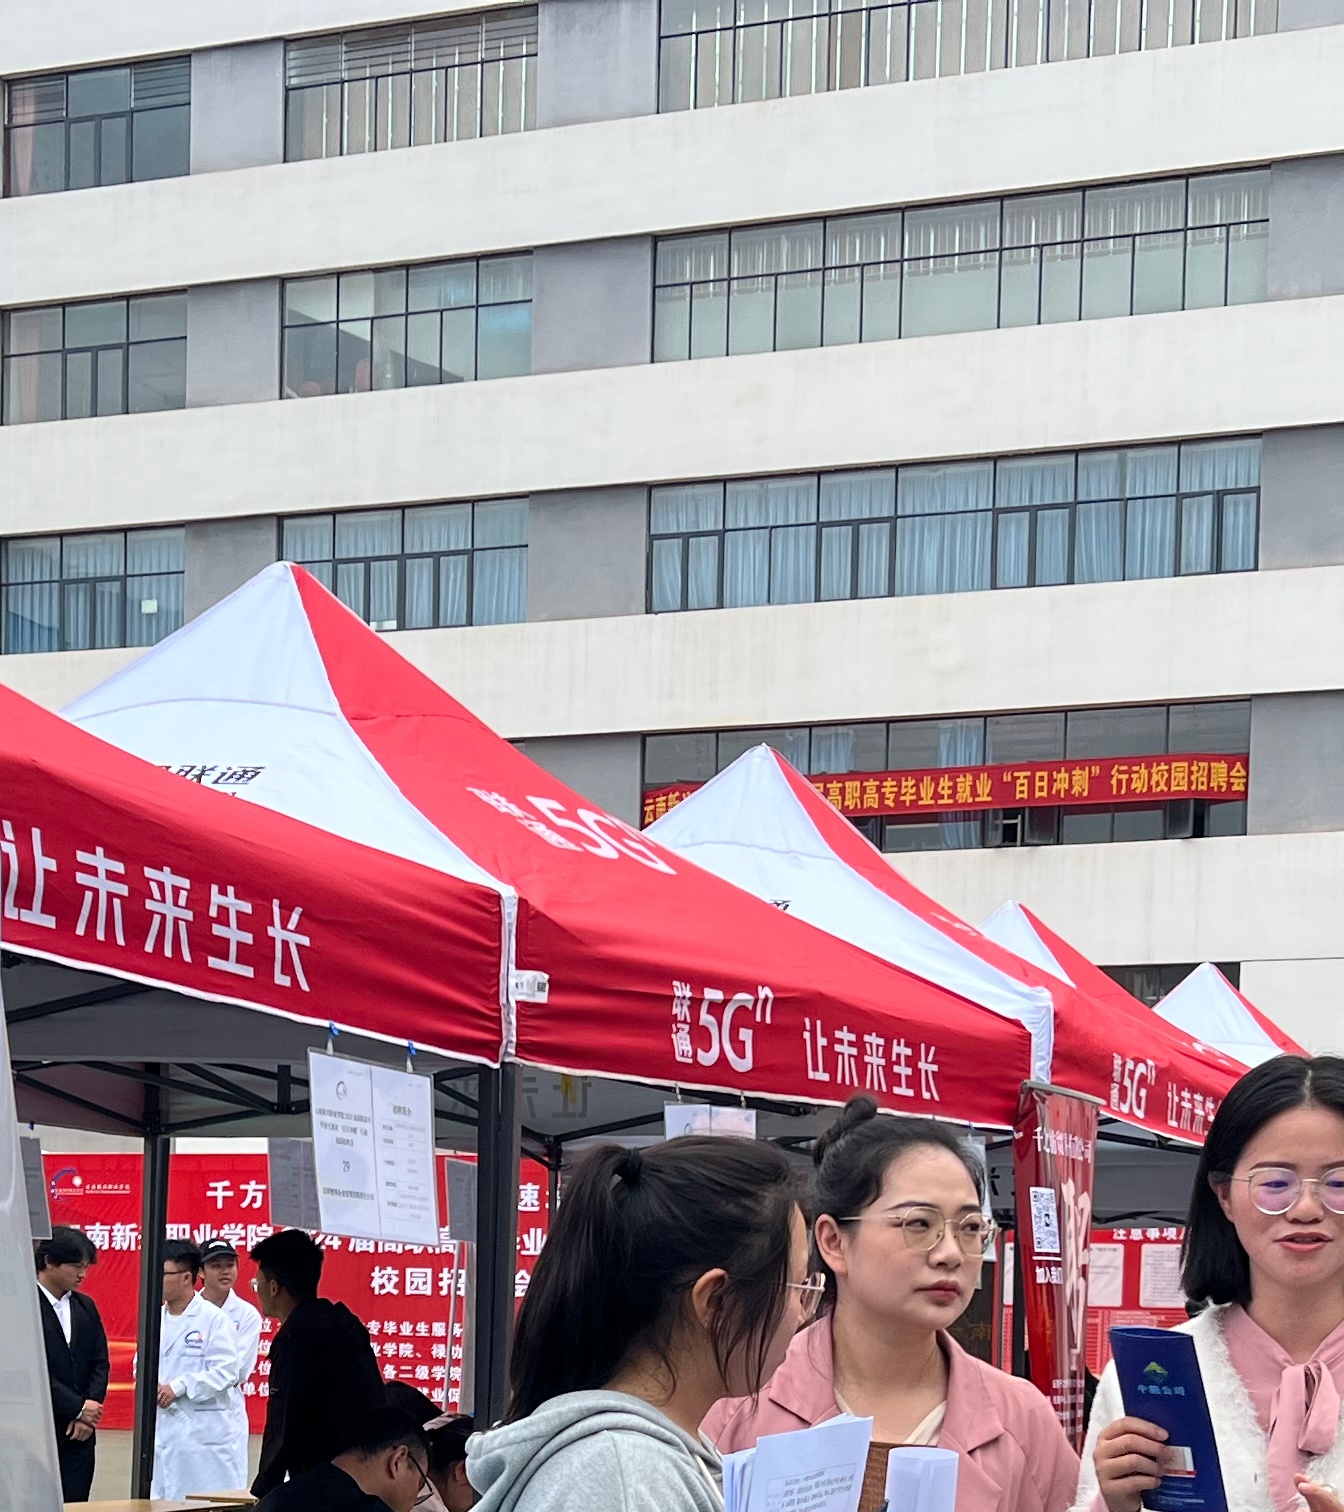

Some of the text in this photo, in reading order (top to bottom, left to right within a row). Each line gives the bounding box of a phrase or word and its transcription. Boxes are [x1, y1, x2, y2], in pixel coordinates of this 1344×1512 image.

[1, 819, 311, 993] 让未来生长
[670, 979, 694, 1065] 联通
[803, 1016, 940, 1102] 让未来生长
[206, 1180, 267, 1210] 千方
